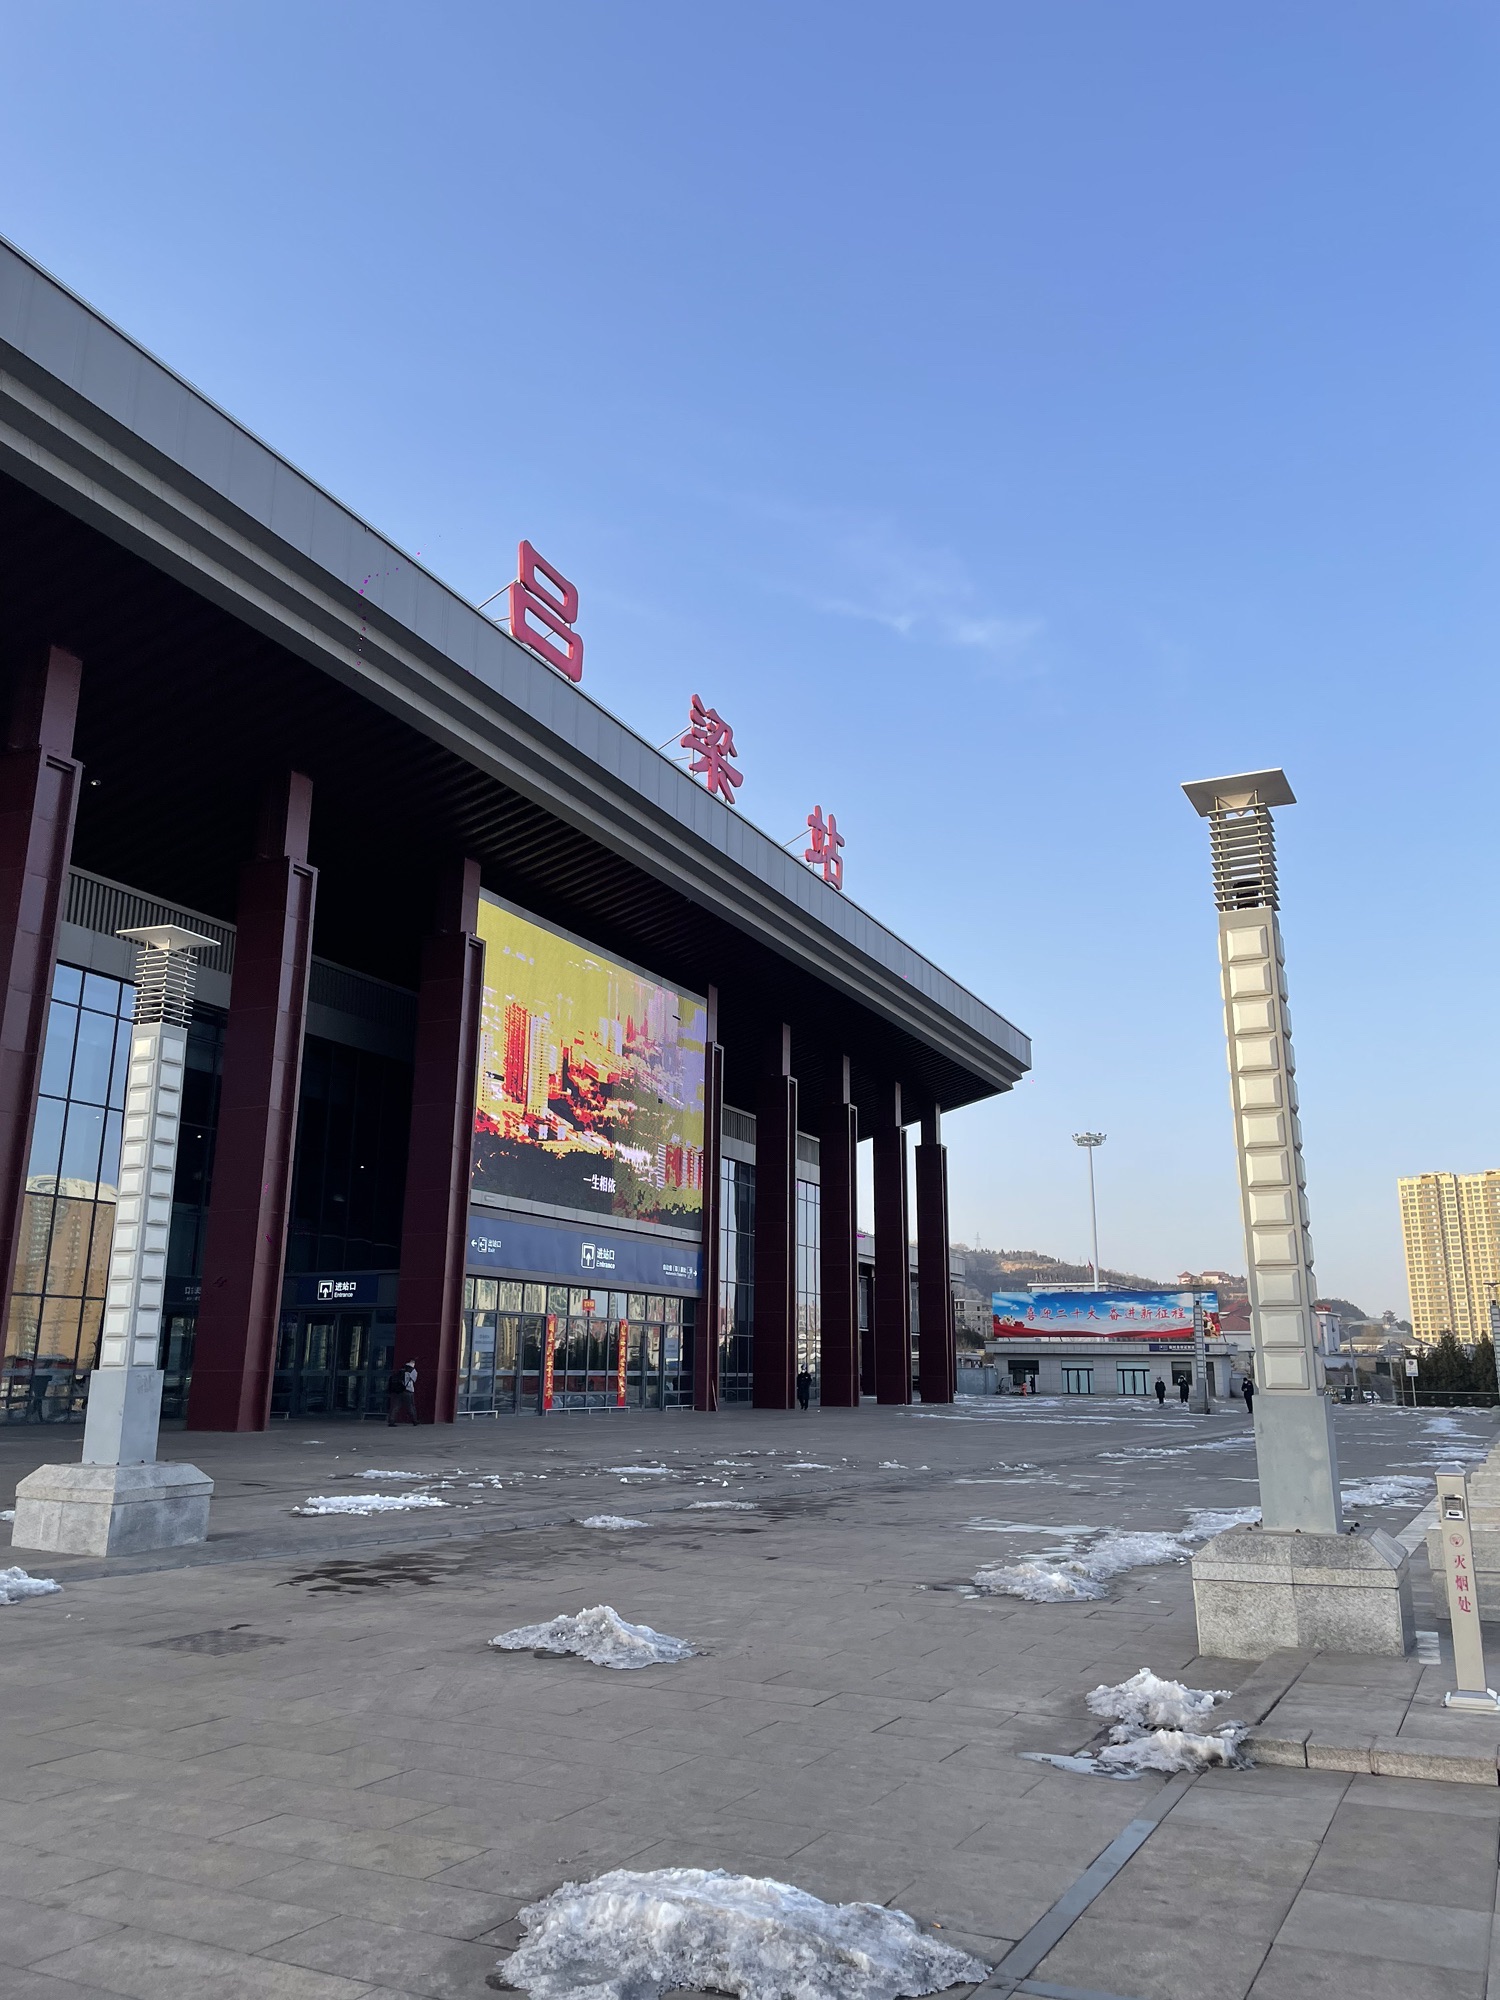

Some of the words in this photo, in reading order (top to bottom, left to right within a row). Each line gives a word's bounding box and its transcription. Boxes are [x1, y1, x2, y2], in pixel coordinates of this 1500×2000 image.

[509, 539, 846, 891] 吕梁站
[582, 1173, 617, 1194] 一生相依
[596, 1247, 615, 1261] 进站口
[595, 1260, 616, 1270] Entrance
[334, 1281, 357, 1291] 进站口
[1024, 1305, 1100, 1321] 喜迎二十大
[1108, 1305, 1187, 1321] 奋进新征程
